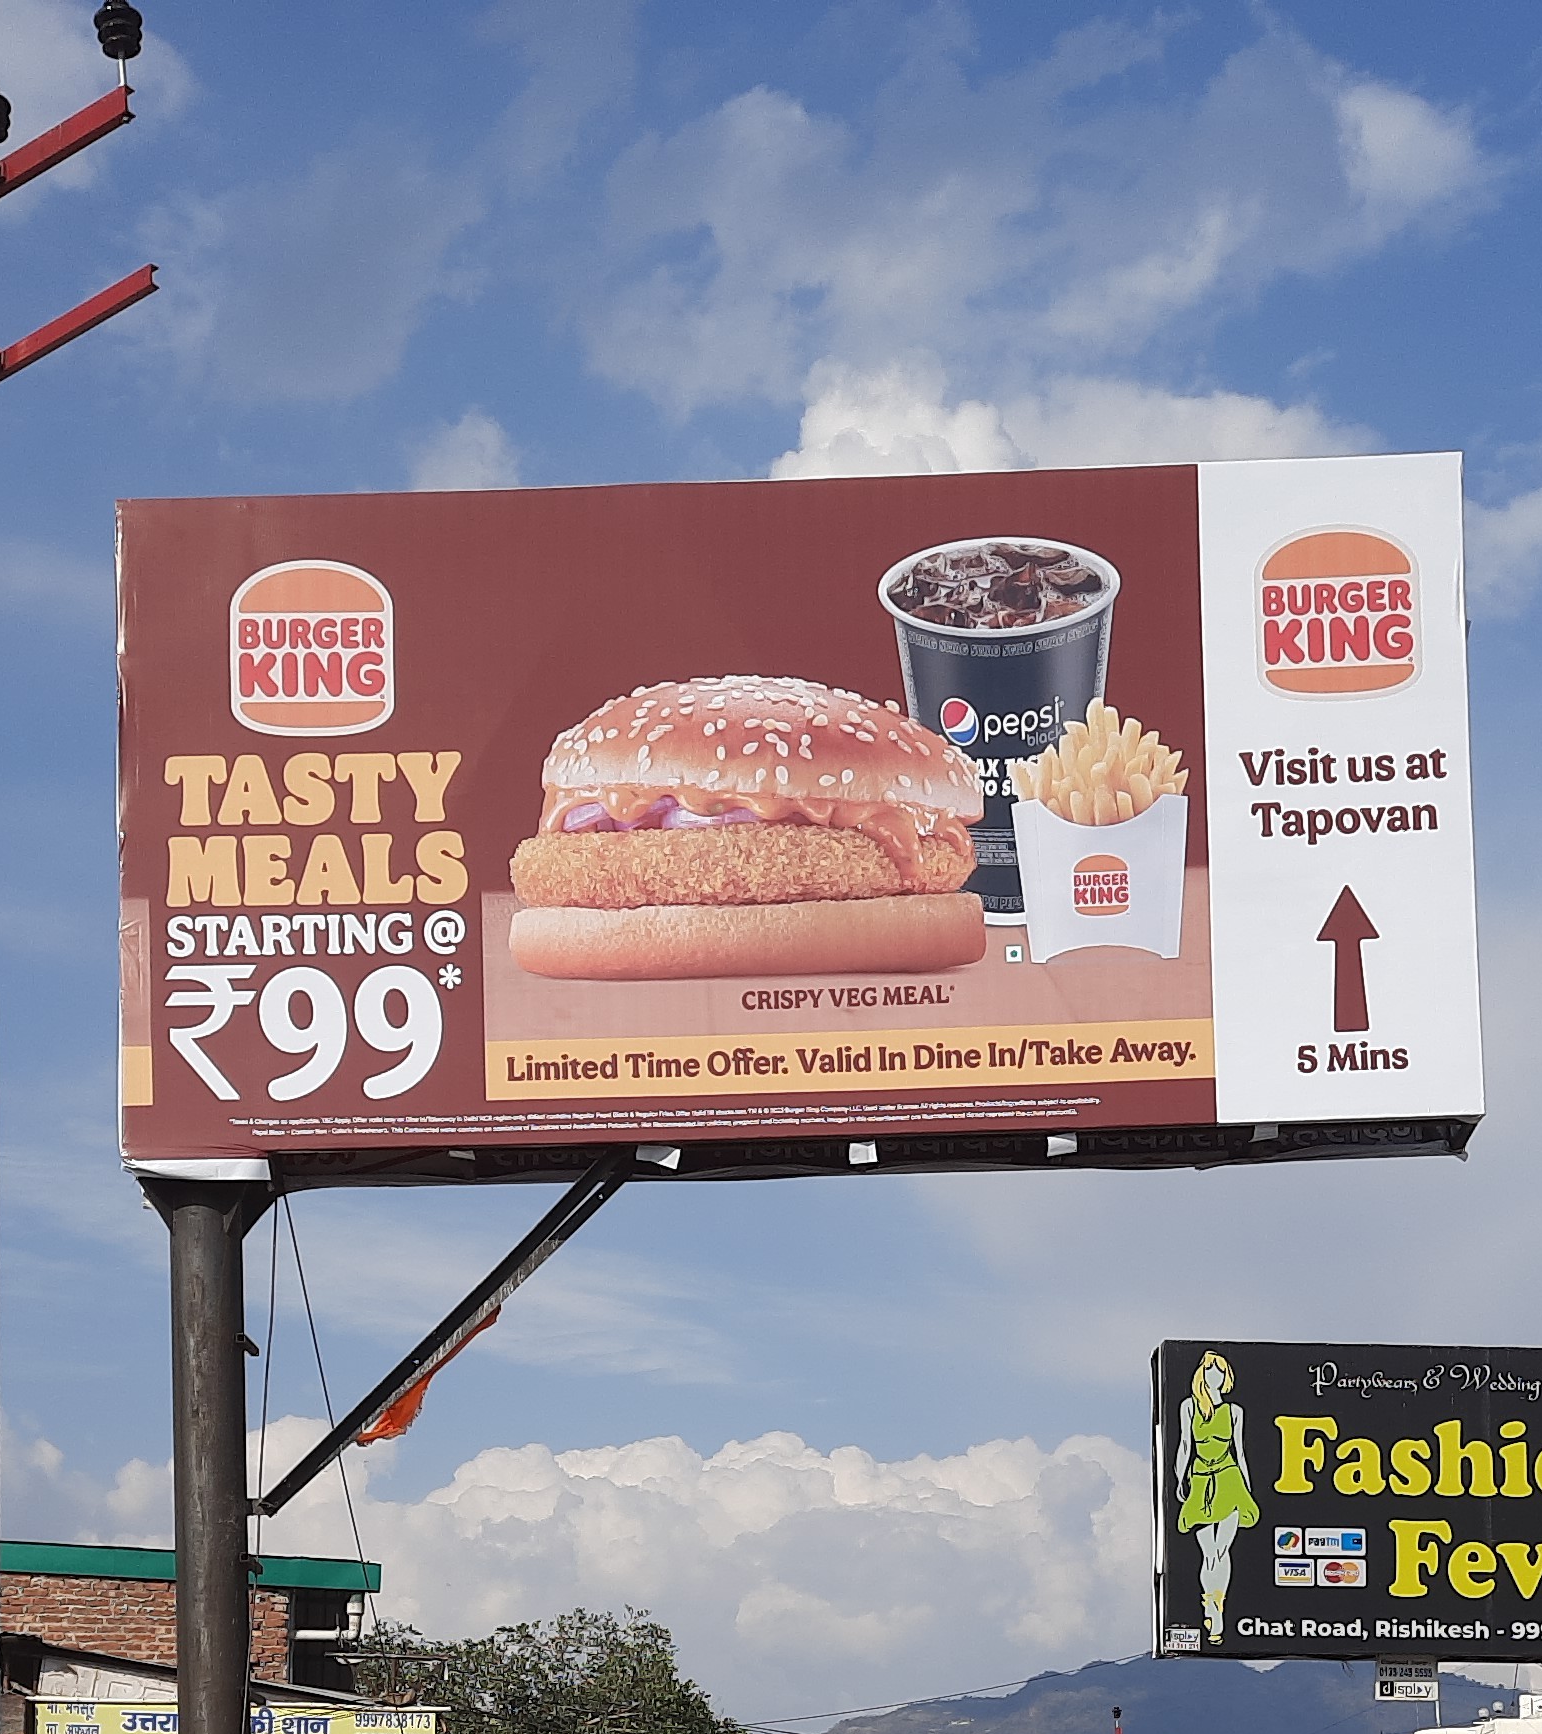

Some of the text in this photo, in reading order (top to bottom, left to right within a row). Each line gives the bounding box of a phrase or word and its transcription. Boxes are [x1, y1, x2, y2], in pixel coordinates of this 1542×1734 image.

[1261, 580, 1413, 617] BURGER
[238, 617, 385, 650] BURGER
[1263, 614, 1415, 665] KING
[238, 652, 386, 698] KING
[983, 697, 1059, 742] pepsi
[1240, 748, 1447, 788] Visit us at
[165, 751, 461, 827] TASTY
[1252, 802, 1438, 846] Tapovan
[166, 831, 470, 908] MEALS
[1073, 873, 1128, 886] BURGER
[1073, 886, 1130, 905] KING
[165, 909, 466, 958] STARTING @
[741, 989, 824, 1011] CRISPY
[829, 987, 879, 1009] VEG
[506, 1036, 1197, 1083] Limited Time Offer. Valid In Dine In/Take Away.
[1297, 1042, 1409, 1074] 5 Mins
[1423, 1365, 1445, 1390] &
[1449, 1364, 1542, 1401] Wedding
[1283, 1568, 1307, 1578] VISA
[1237, 1617, 1296, 1637] Ghat
[1302, 1619, 1369, 1641] Road,
[1375, 1619, 1490, 1641] Rishikesh
[354, 1713, 432, 1730] 9997838173
